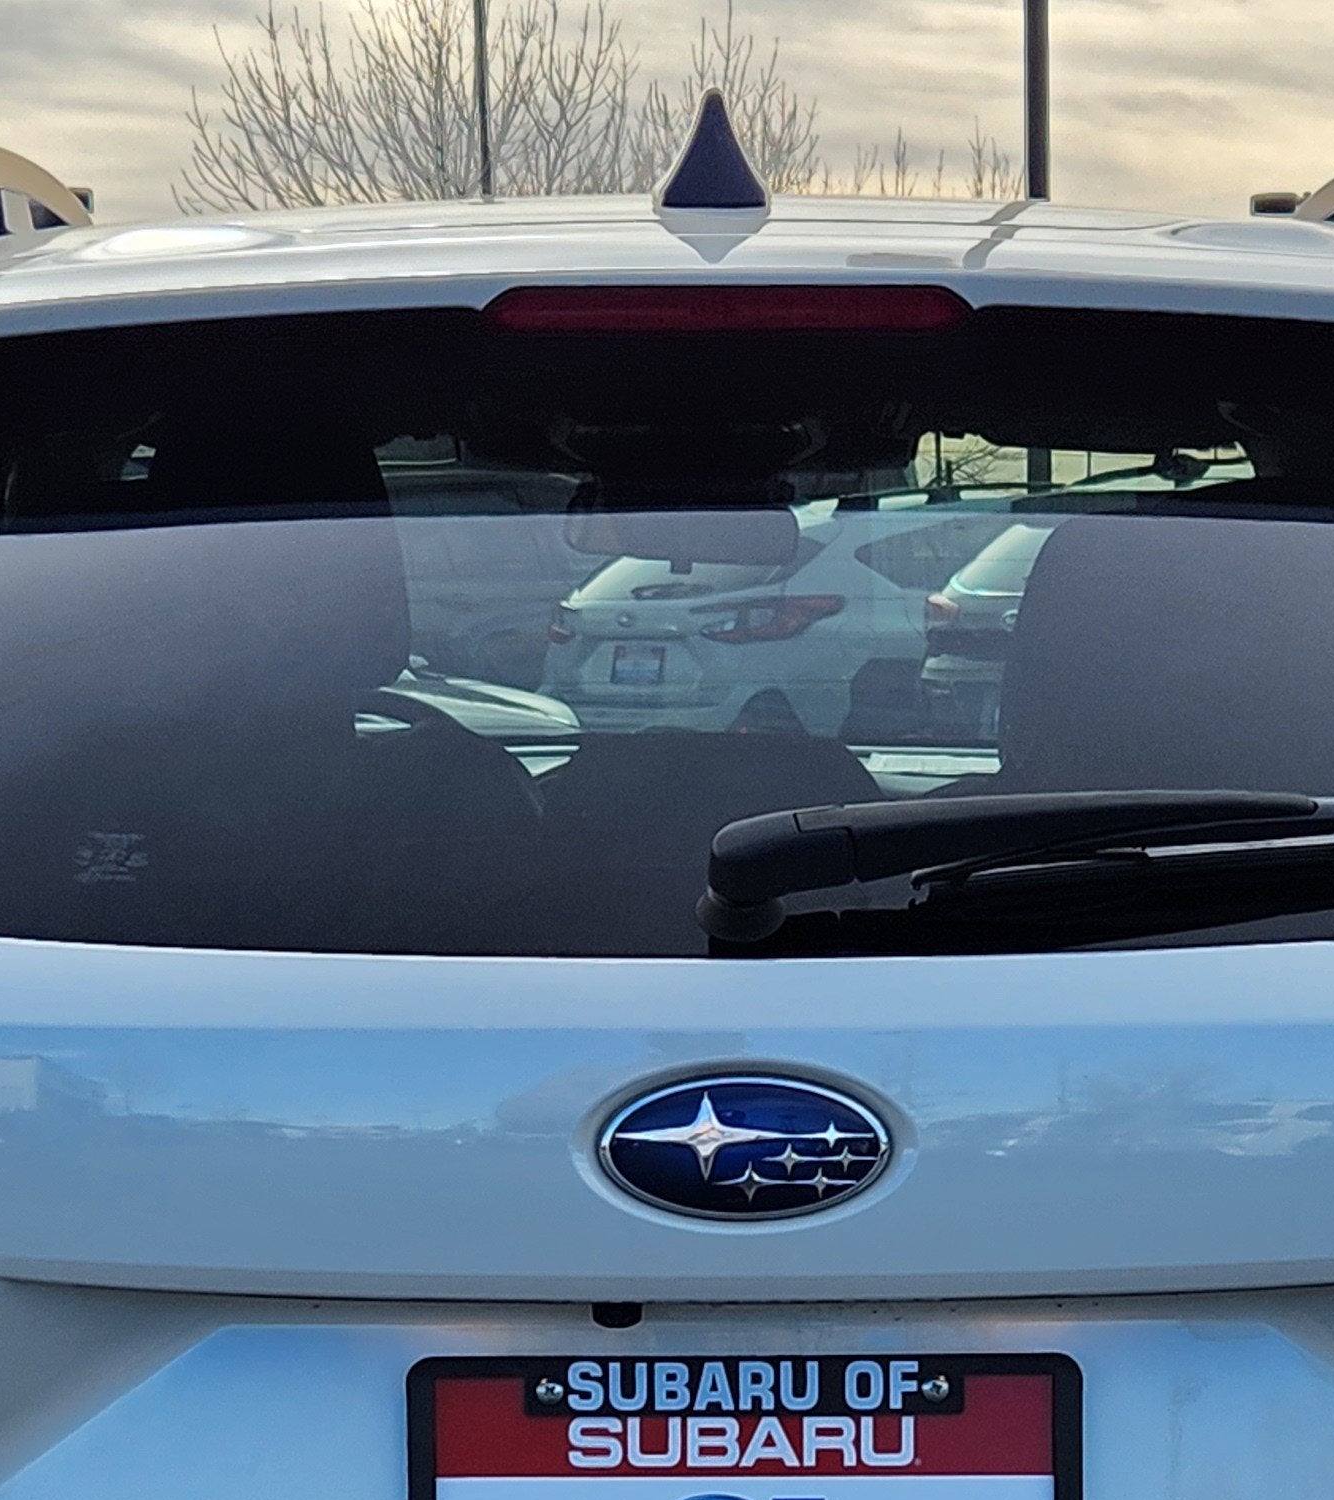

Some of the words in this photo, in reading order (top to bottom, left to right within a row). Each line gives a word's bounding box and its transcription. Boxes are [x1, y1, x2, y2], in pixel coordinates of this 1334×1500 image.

[567, 1361, 819, 1412] SUBARU
[844, 1360, 919, 1411] OF
[568, 1416, 916, 1469] SUBARU
